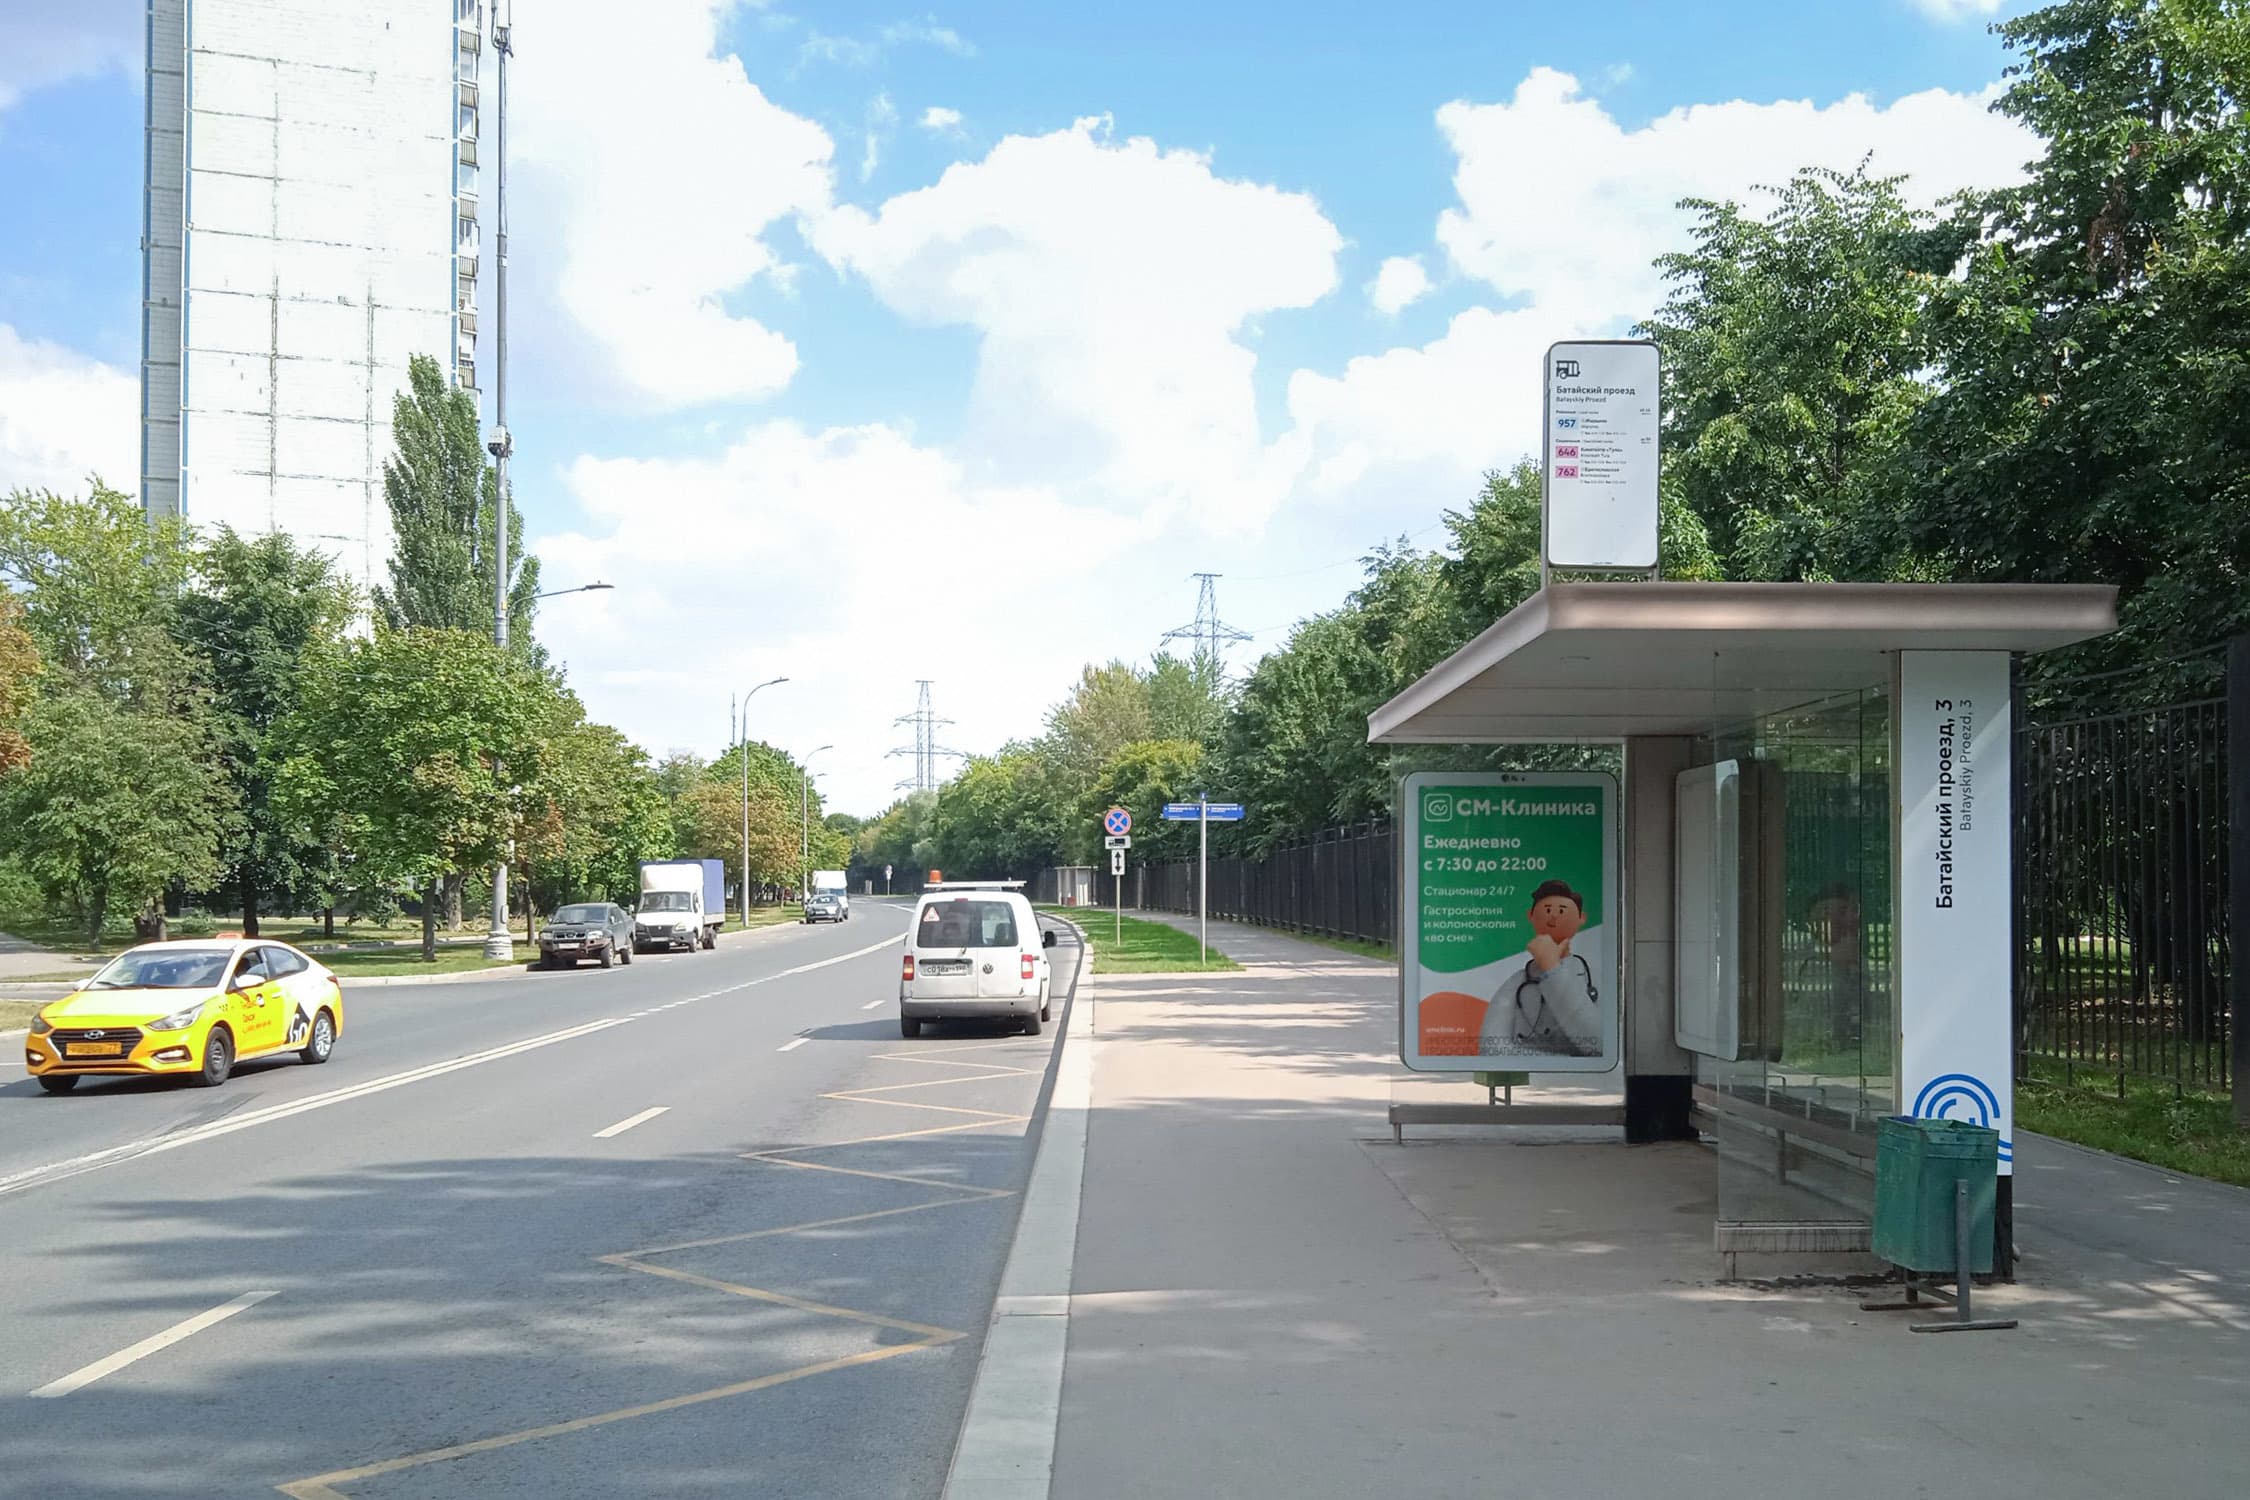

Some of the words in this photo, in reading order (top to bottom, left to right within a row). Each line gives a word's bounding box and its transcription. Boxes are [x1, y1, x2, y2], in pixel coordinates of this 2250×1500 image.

[1556, 386, 1602, 394] Батайский
[1604, 387, 1635, 396] проезд
[1558, 419, 1576, 428] 957
[1558, 448, 1576, 457] 646
[1558, 467, 1575, 477] 762
[1936, 699, 1953, 711] 3
[1960, 699, 1972, 708] 3
[1960, 712, 1973, 763] Proezd,
[1938, 718, 1955, 797] проезд,
[1960, 769, 1974, 831] Batayskiy
[1456, 798, 1596, 816] СМ-Клиника
[1424, 835, 1521, 850] Ежедневно
[1936, 803, 1953, 908] Батайский
[1424, 860, 1432, 871] с
[1437, 858, 1472, 871] 7:30
[1475, 860, 1497, 873] до
[1501, 857, 1547, 871] 22:00
[1423, 886, 1487, 898] Стационар
[1489, 886, 1515, 896] 24/7
[1423, 905, 1503, 917] Гастроскопия
[1423, 921, 1431, 929] и
[1432, 921, 1516, 929] колоноскопия
